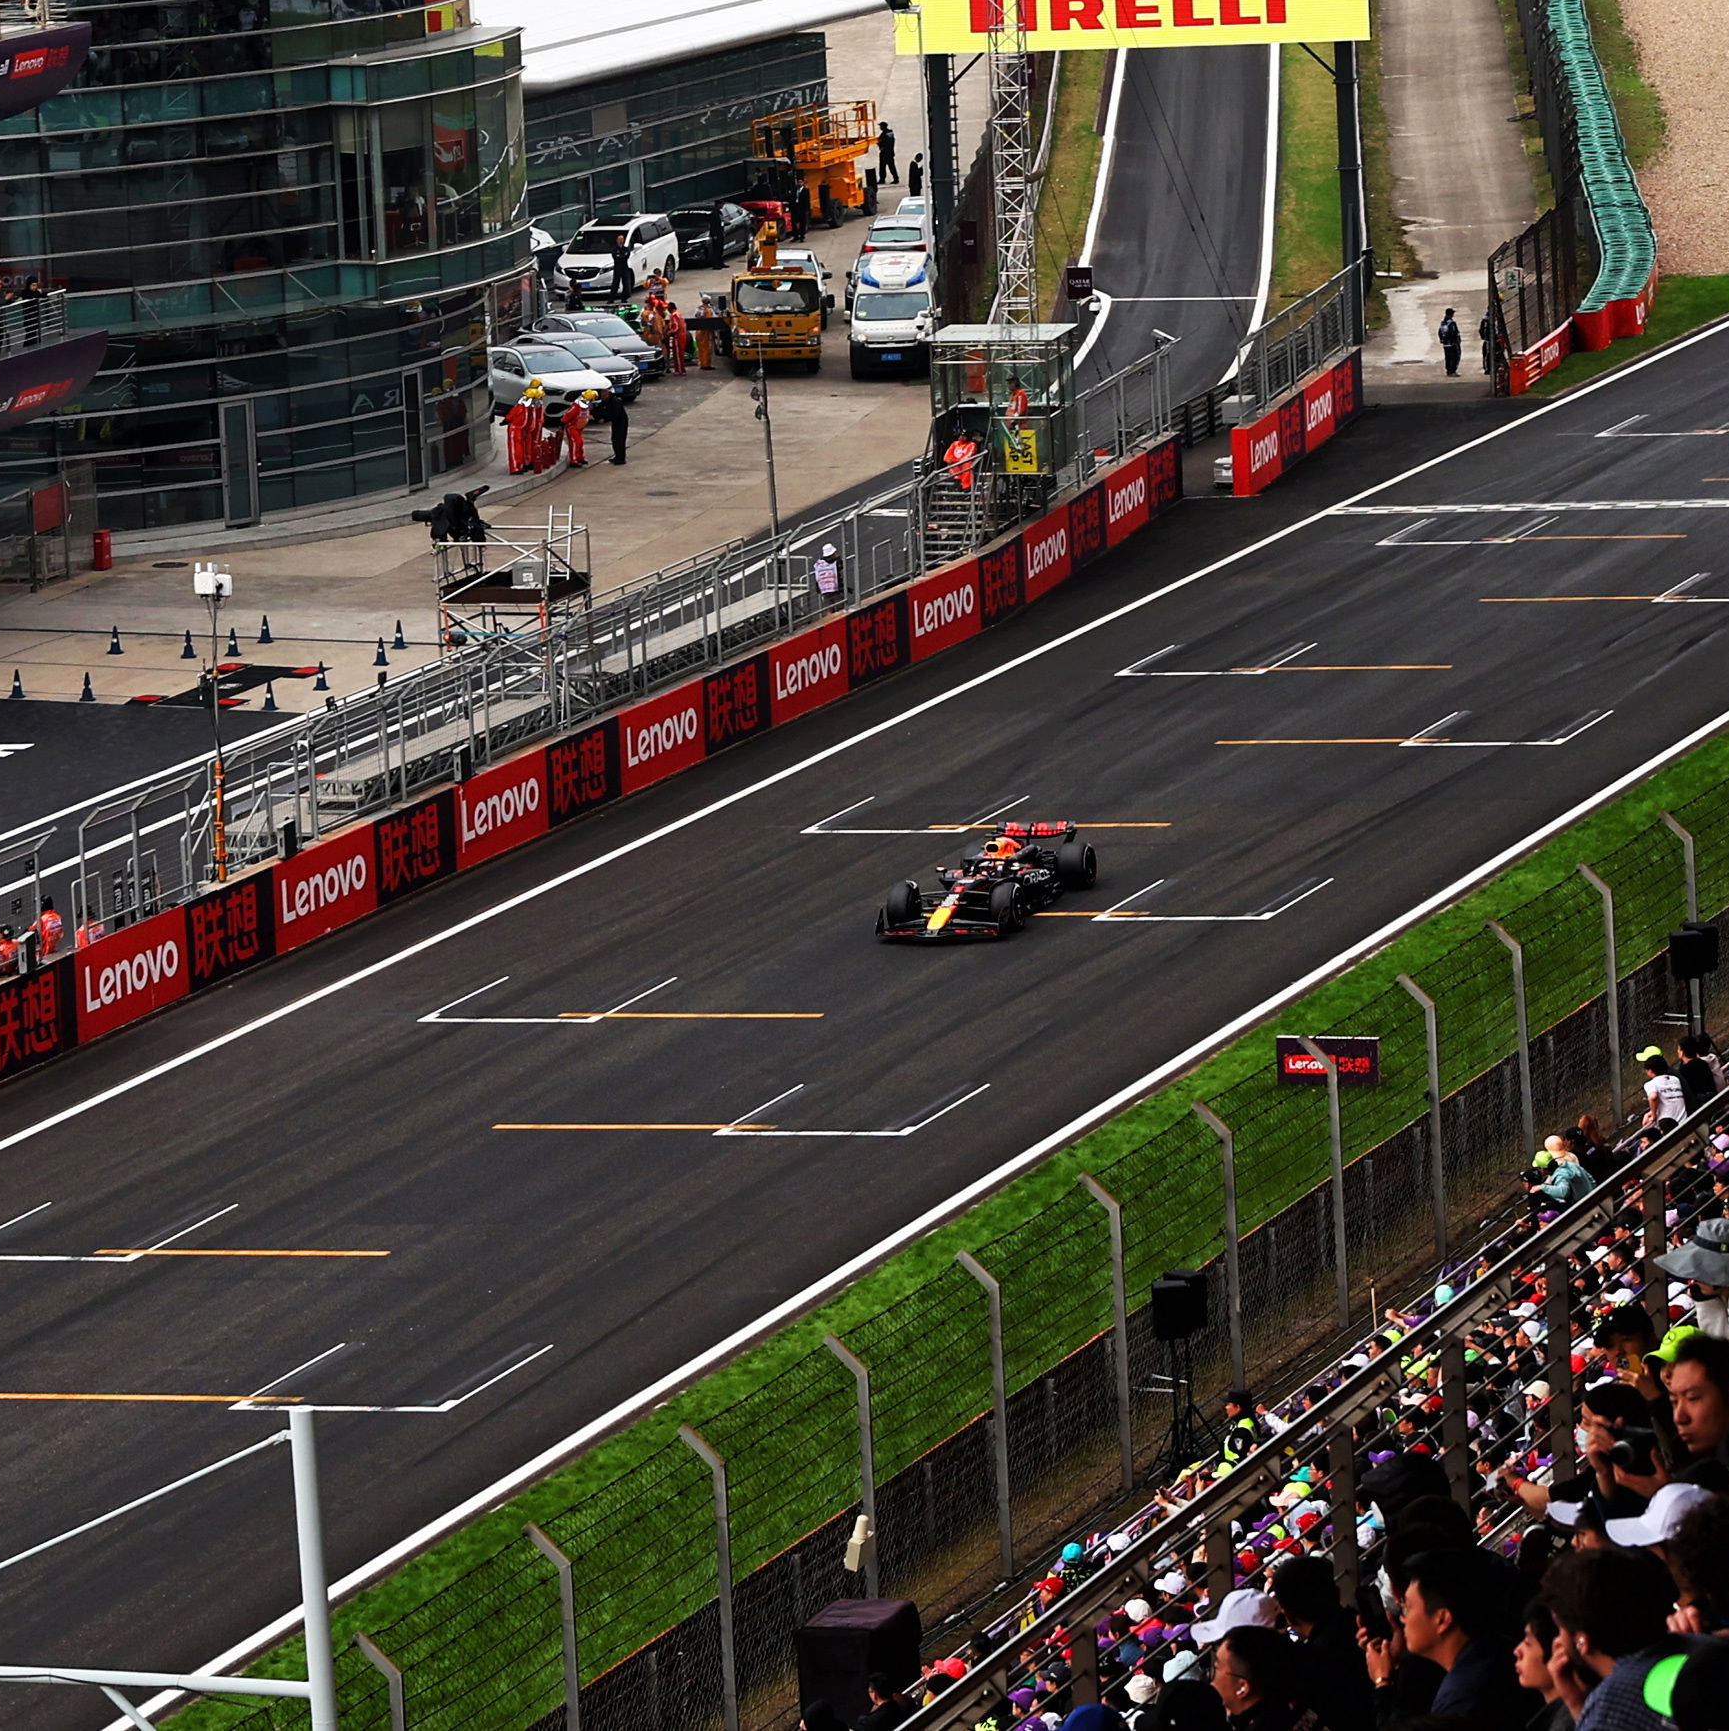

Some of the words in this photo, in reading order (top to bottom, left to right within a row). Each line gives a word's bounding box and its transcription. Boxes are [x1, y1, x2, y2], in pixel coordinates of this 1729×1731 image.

[14, 57, 44, 73] Lenovo
[0, 396, 14, 414] all
[16, 390, 47, 408] Lenovo
[1305, 388, 1333, 431] Lenovo
[1250, 429, 1279, 473] Lenovo
[1071, 491, 1101, 560] 联想
[1109, 475, 1145, 524] Lenovo
[984, 543, 1018, 619] 联想
[1027, 527, 1067, 579] Lenovo
[850, 601, 897, 677] 联想
[913, 583, 974, 638] Lenovo
[707, 663, 758, 743] 联想
[776, 643, 842, 701] Lenovo
[627, 707, 698, 768] Lenovo
[551, 730, 607, 815] 联想
[462, 777, 540, 843] Lenovo
[379, 803, 440, 892] 联想
[281, 854, 367, 925] Lenovo
[192, 883, 260, 979] 联想
[85, 940, 179, 1013] Lenovo
